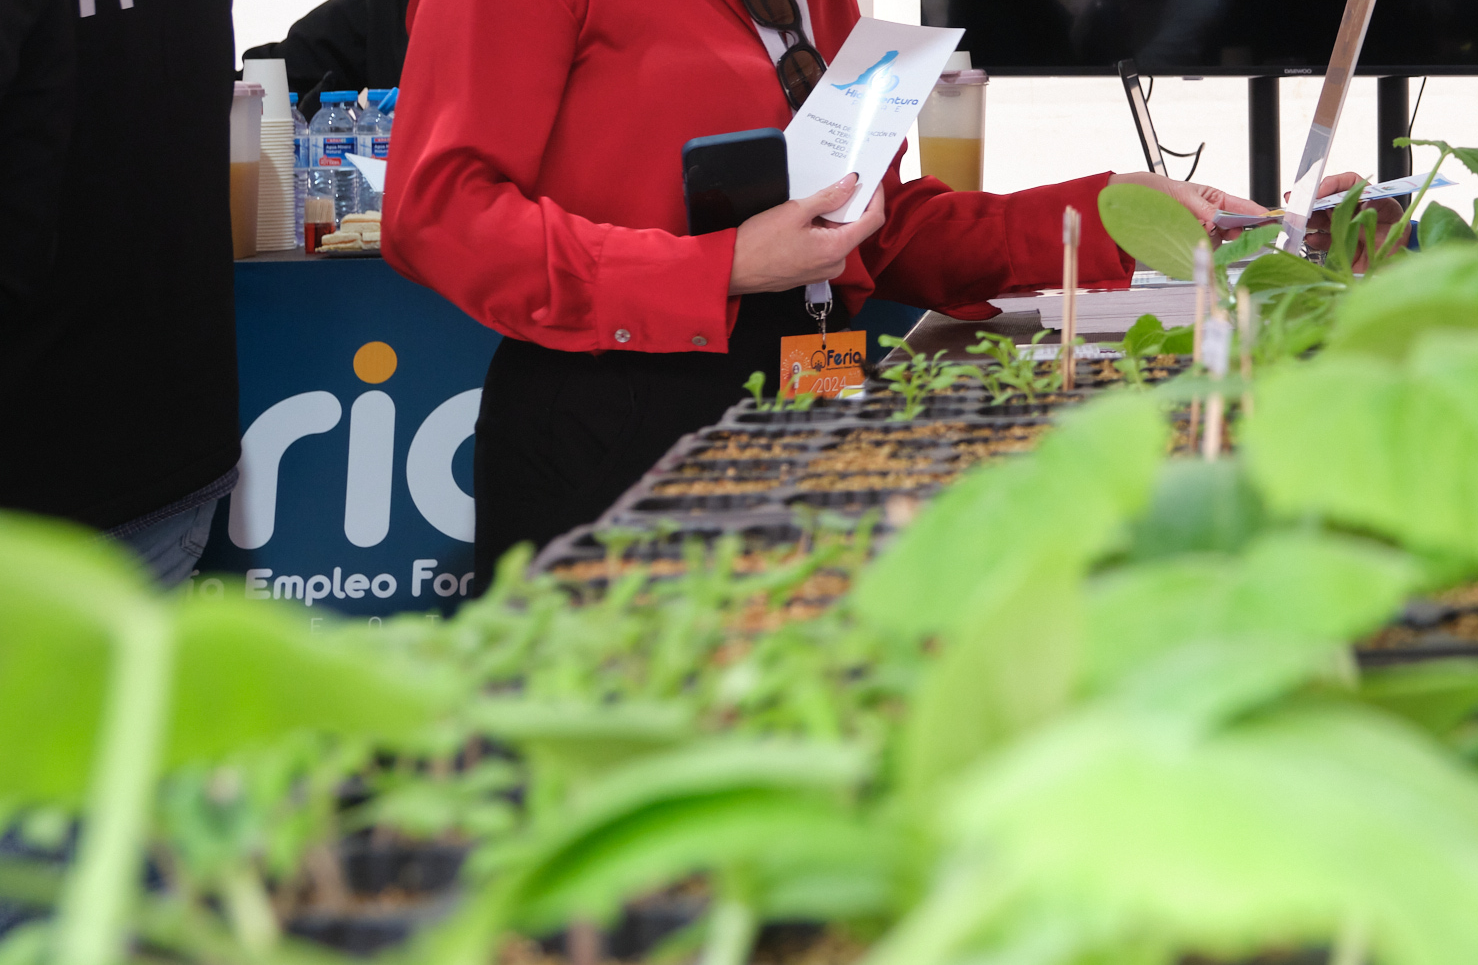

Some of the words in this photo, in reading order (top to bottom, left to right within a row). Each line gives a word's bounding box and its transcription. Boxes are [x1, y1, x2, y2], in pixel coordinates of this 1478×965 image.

[806, 112, 842, 130] PROGRAMA
[827, 348, 862, 367] Feria
[816, 376, 847, 394] 2024
[244, 566, 398, 607] Empleo
